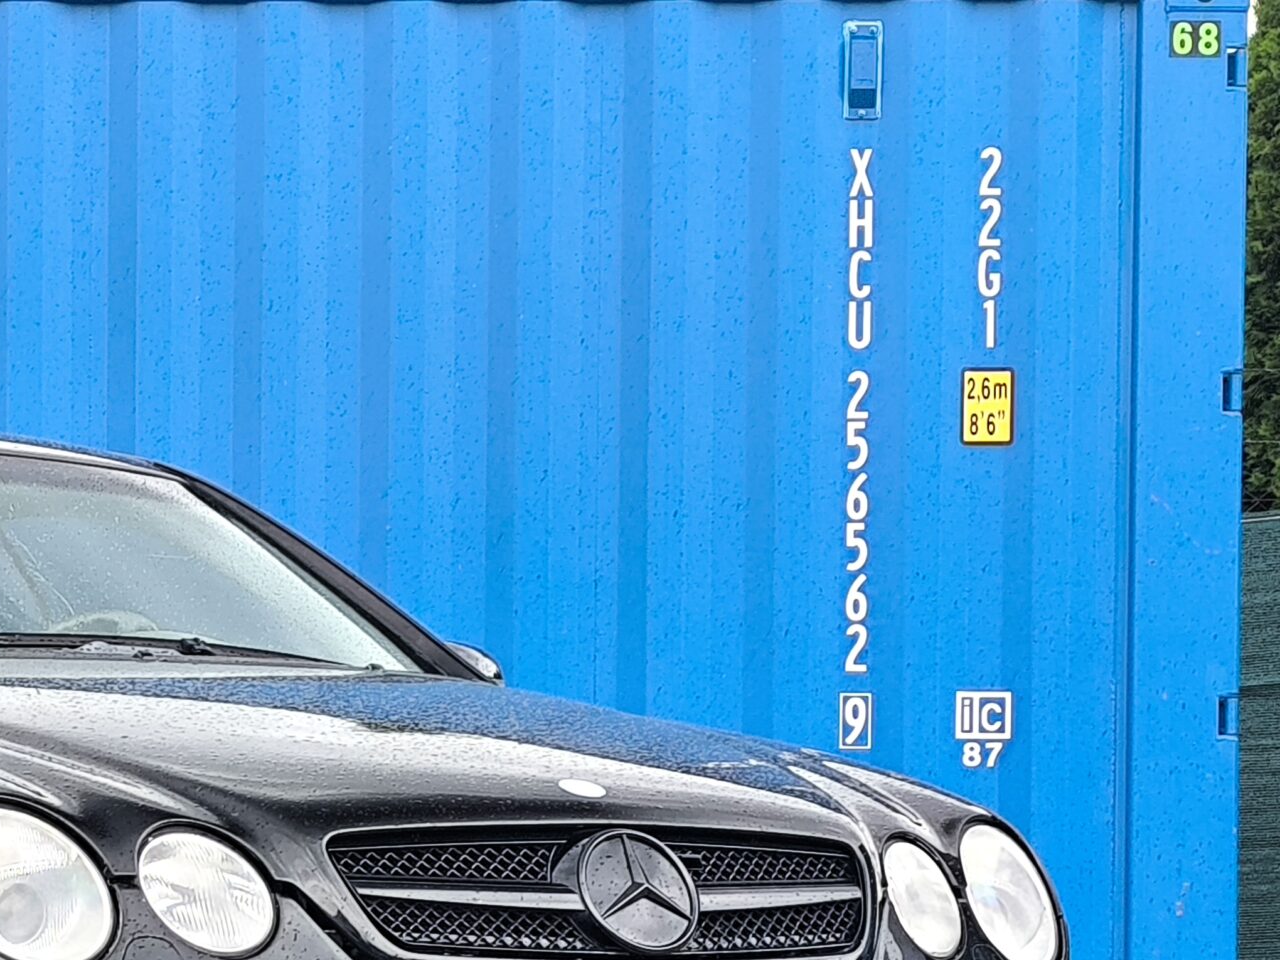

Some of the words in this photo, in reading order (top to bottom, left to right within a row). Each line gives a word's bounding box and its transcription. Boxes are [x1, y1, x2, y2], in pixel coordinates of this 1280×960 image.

[1172, 21, 1219, 56] 68
[848, 148, 874, 350] XHCU
[977, 146, 1002, 348] 22G1
[845, 370, 869, 672] 256562
[845, 697, 867, 745] 9
[962, 741, 1003, 768] 87
